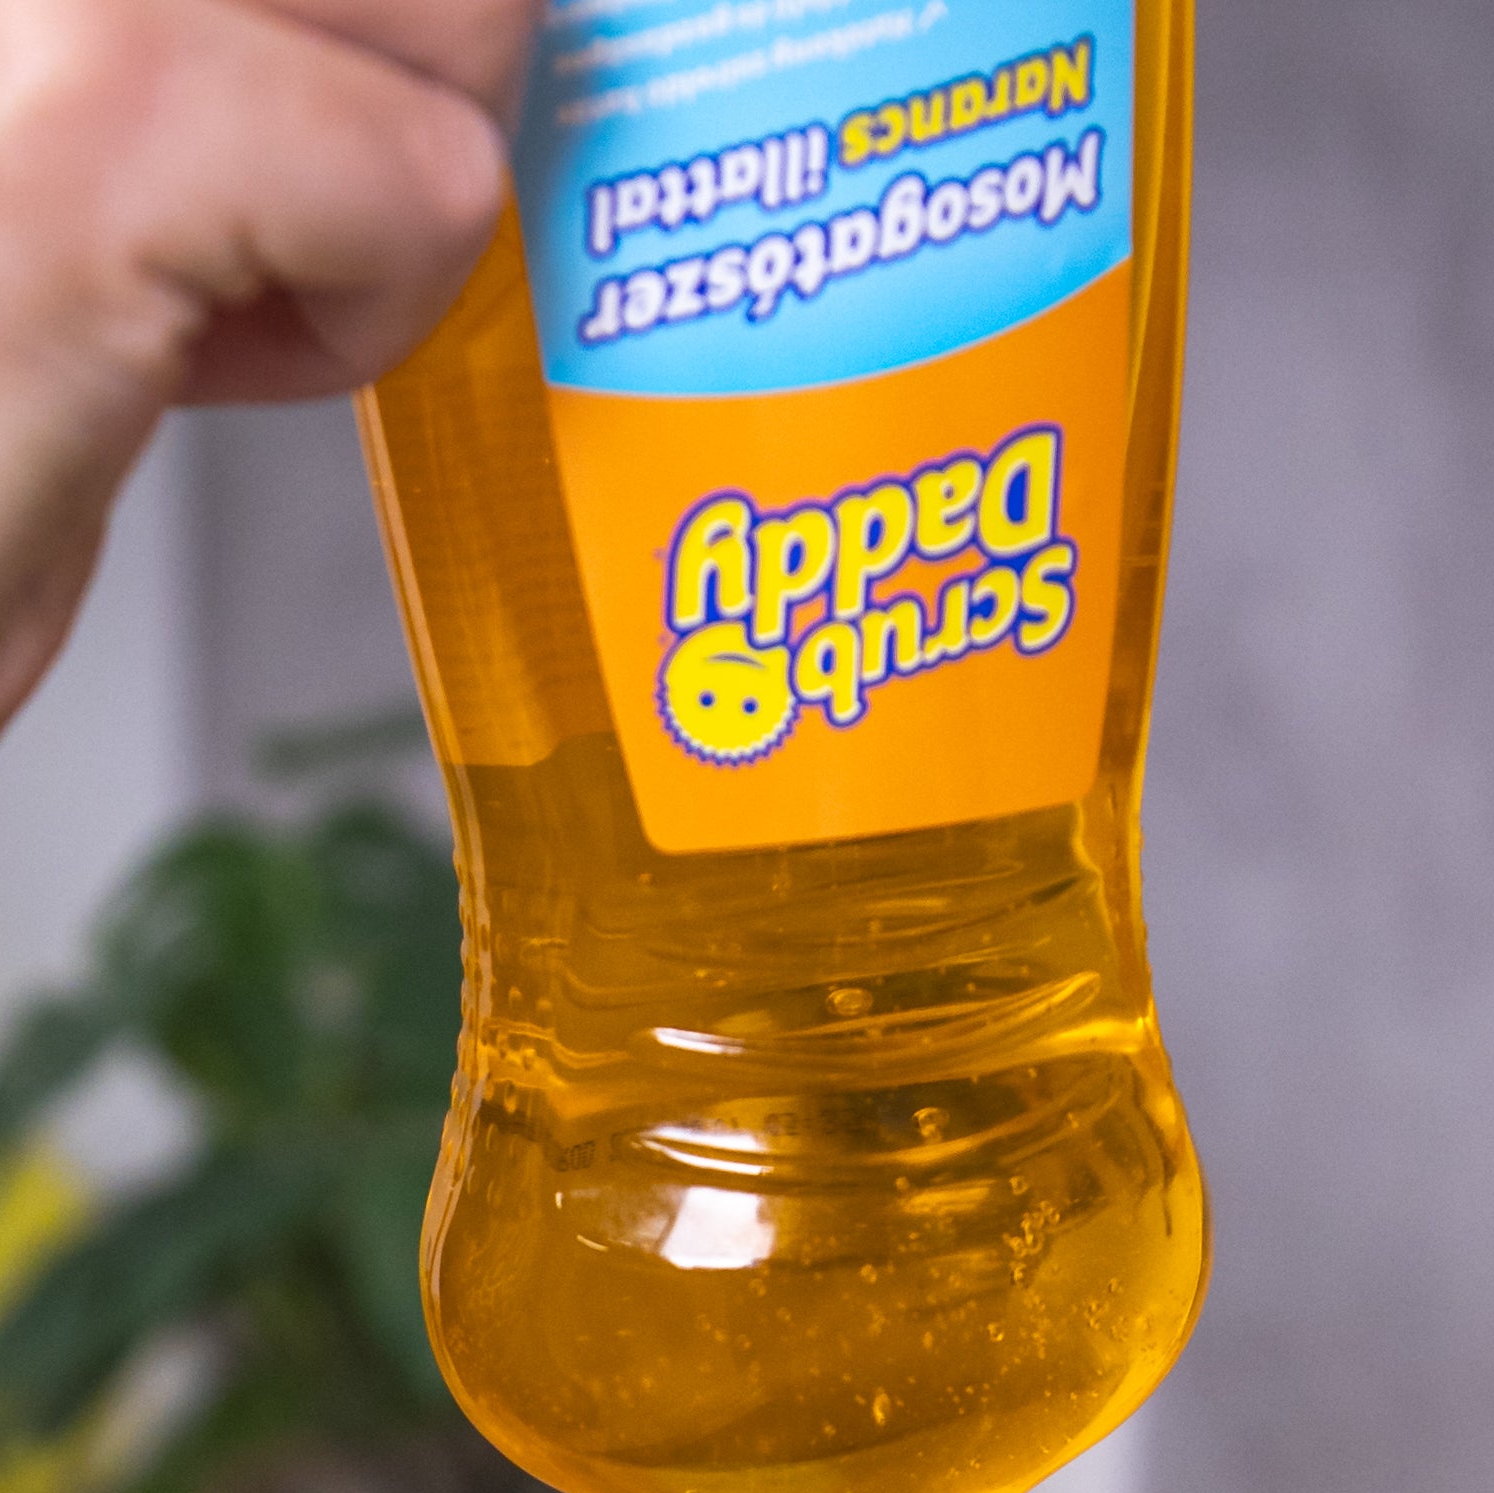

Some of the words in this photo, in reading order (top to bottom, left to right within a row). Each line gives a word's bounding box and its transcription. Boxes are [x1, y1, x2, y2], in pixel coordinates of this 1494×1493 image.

[587, 123, 829, 256] illattal
[834, 38, 1094, 170] Narancs
[580, 130, 1101, 347] Mosogatószer
[666, 418, 1063, 650] Daddy
[789, 536, 1076, 728] Scrub
